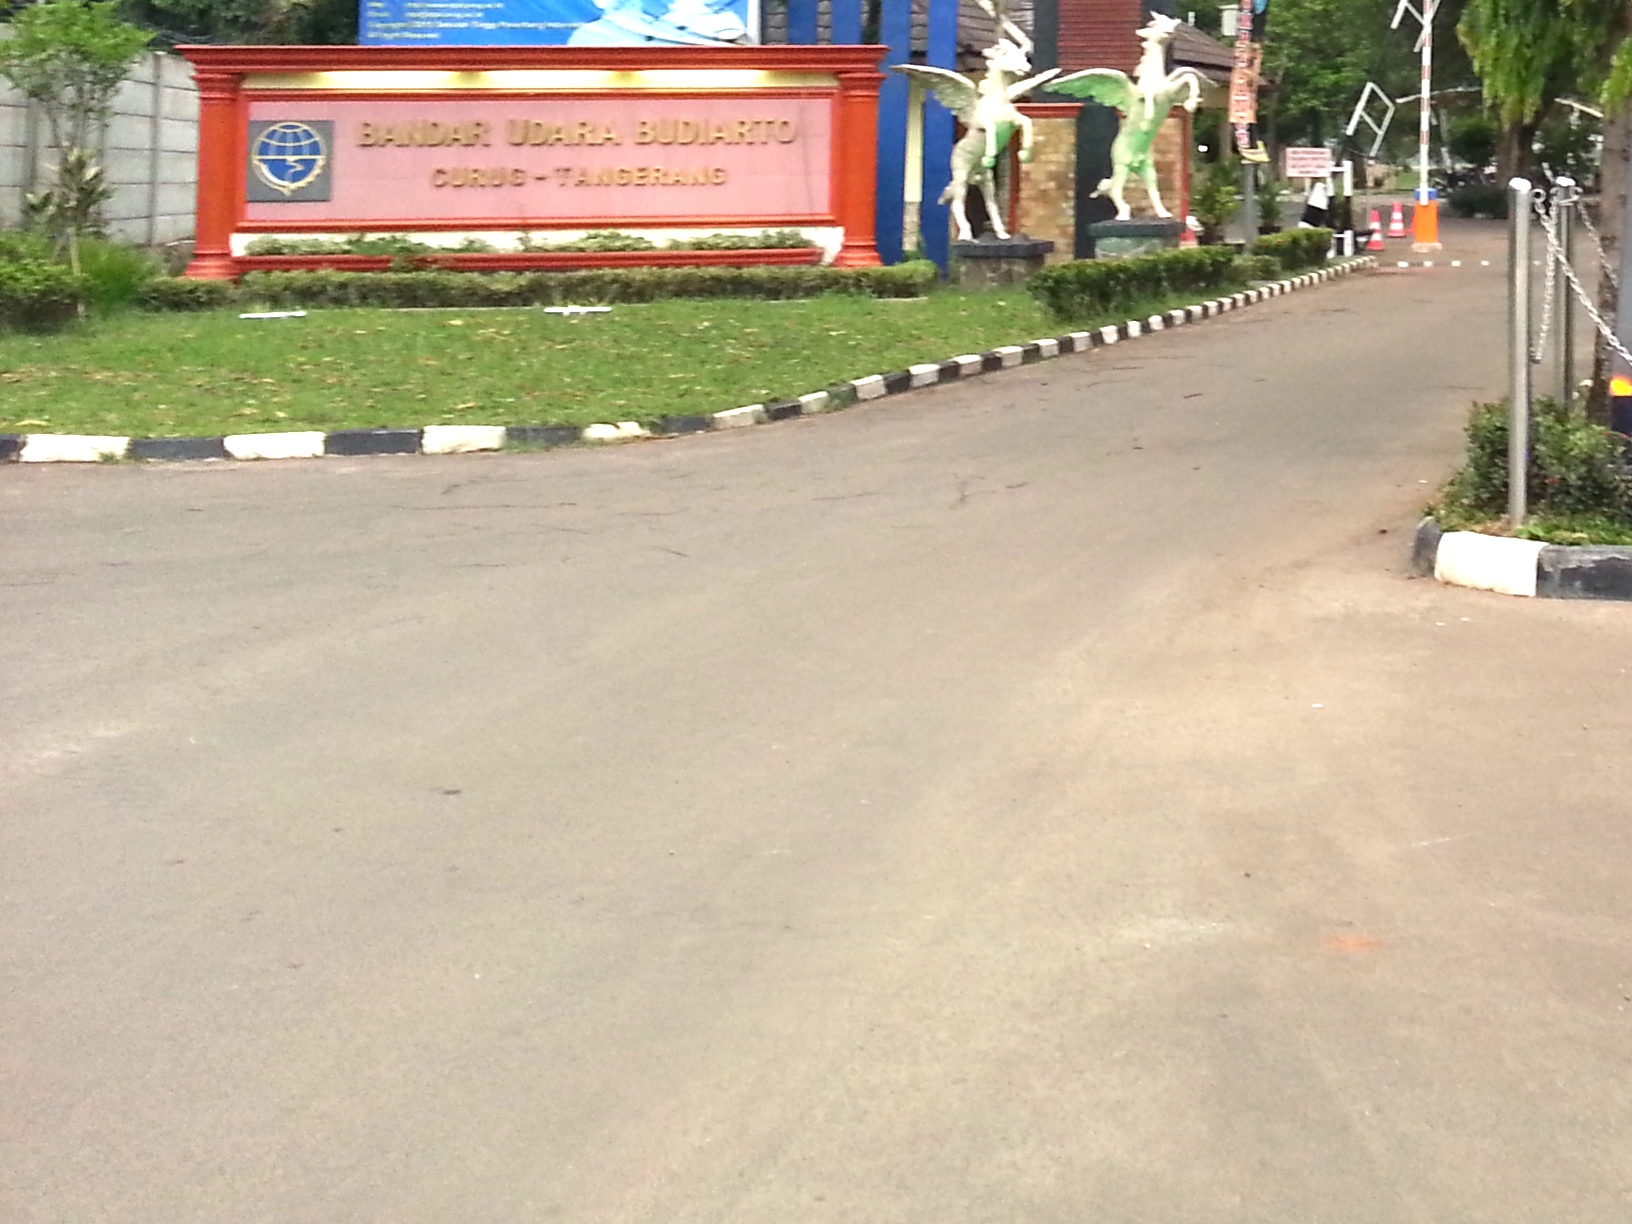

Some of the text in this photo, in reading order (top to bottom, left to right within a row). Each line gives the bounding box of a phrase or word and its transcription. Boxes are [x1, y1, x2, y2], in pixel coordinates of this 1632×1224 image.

[354, 119, 795, 147] BANDAR UDARA BUDIARTO
[431, 167, 526, 188] CURUG
[554, 166, 727, 188] TANGERANG
